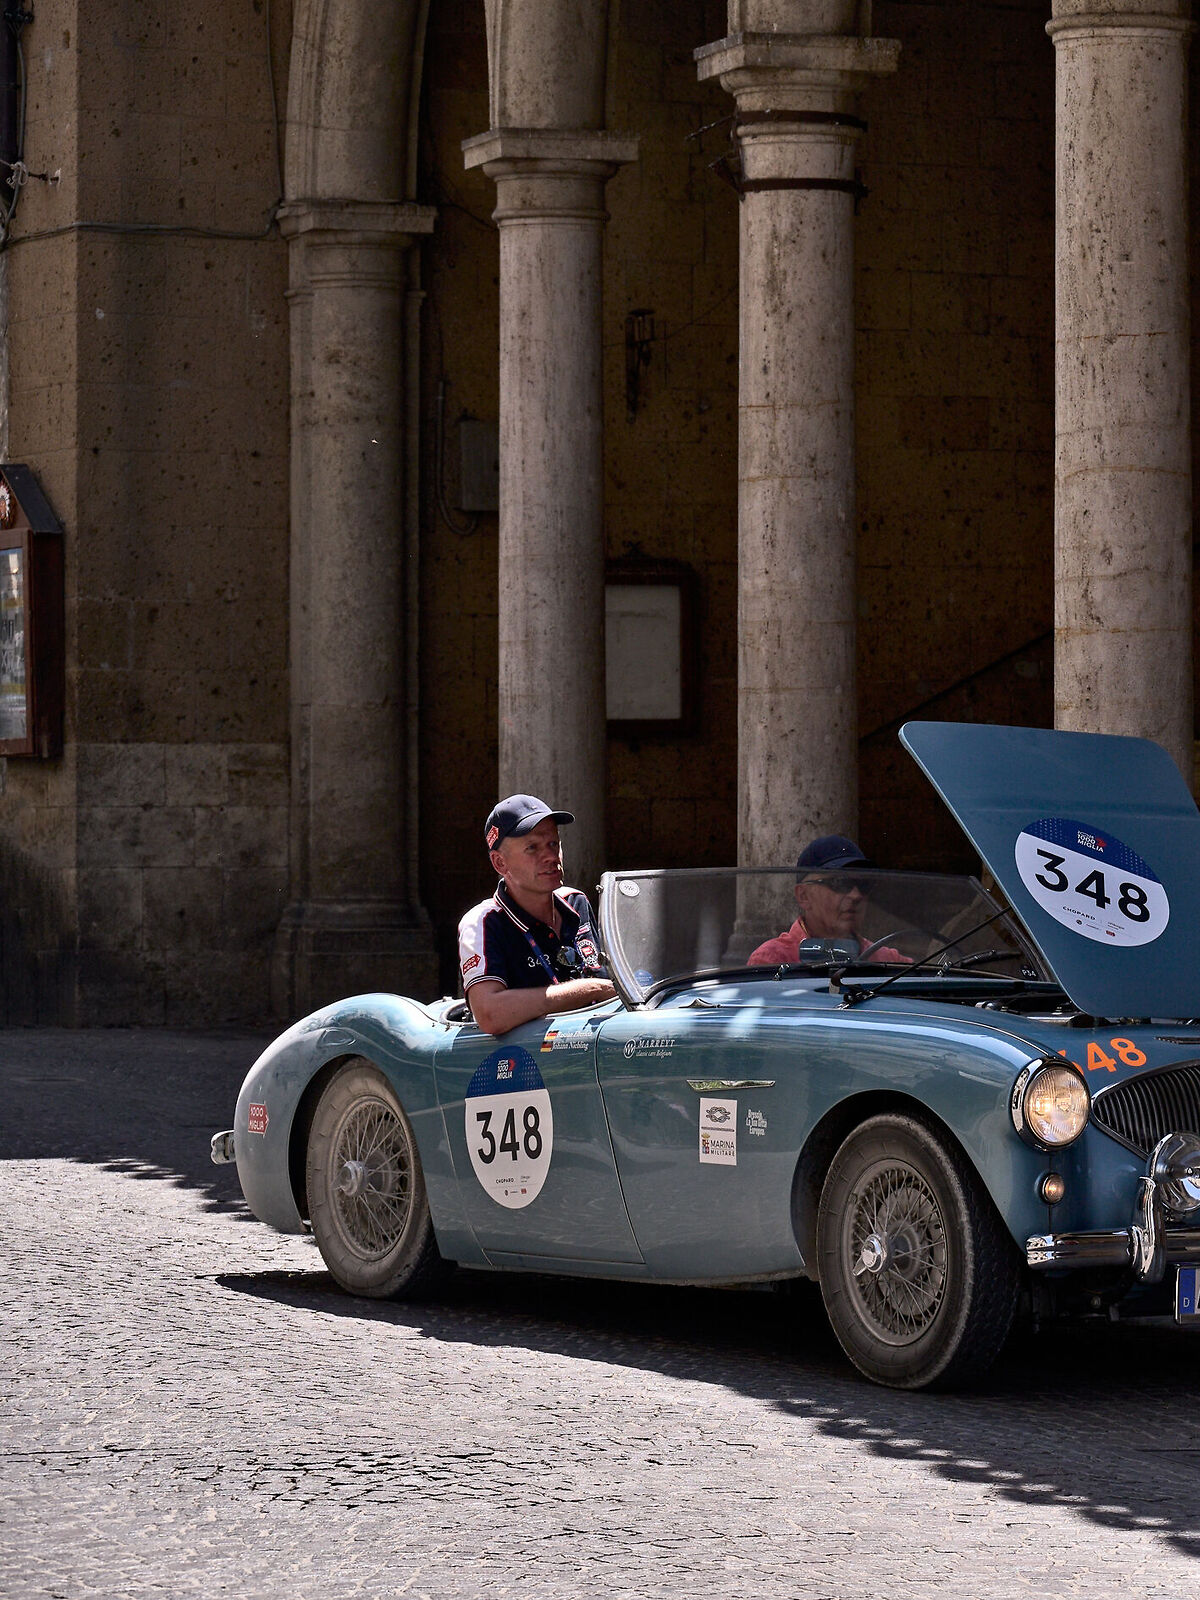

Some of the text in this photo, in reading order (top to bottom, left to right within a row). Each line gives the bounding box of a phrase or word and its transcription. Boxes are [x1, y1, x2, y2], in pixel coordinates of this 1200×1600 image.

[1077, 838, 1104, 853] MIGLIA
[1034, 848, 1151, 923] 348
[1062, 905, 1096, 921] CHOPARD
[1057, 1037, 1147, 1075] 48
[496, 1070, 513, 1080] MIGLIA
[250, 1106, 264, 1117] 1000
[476, 1105, 543, 1165] 348
[710, 1139, 735, 1149] MARINA
[710, 1149, 735, 1157] MILITARE
[1183, 1297, 1190, 1308] D
